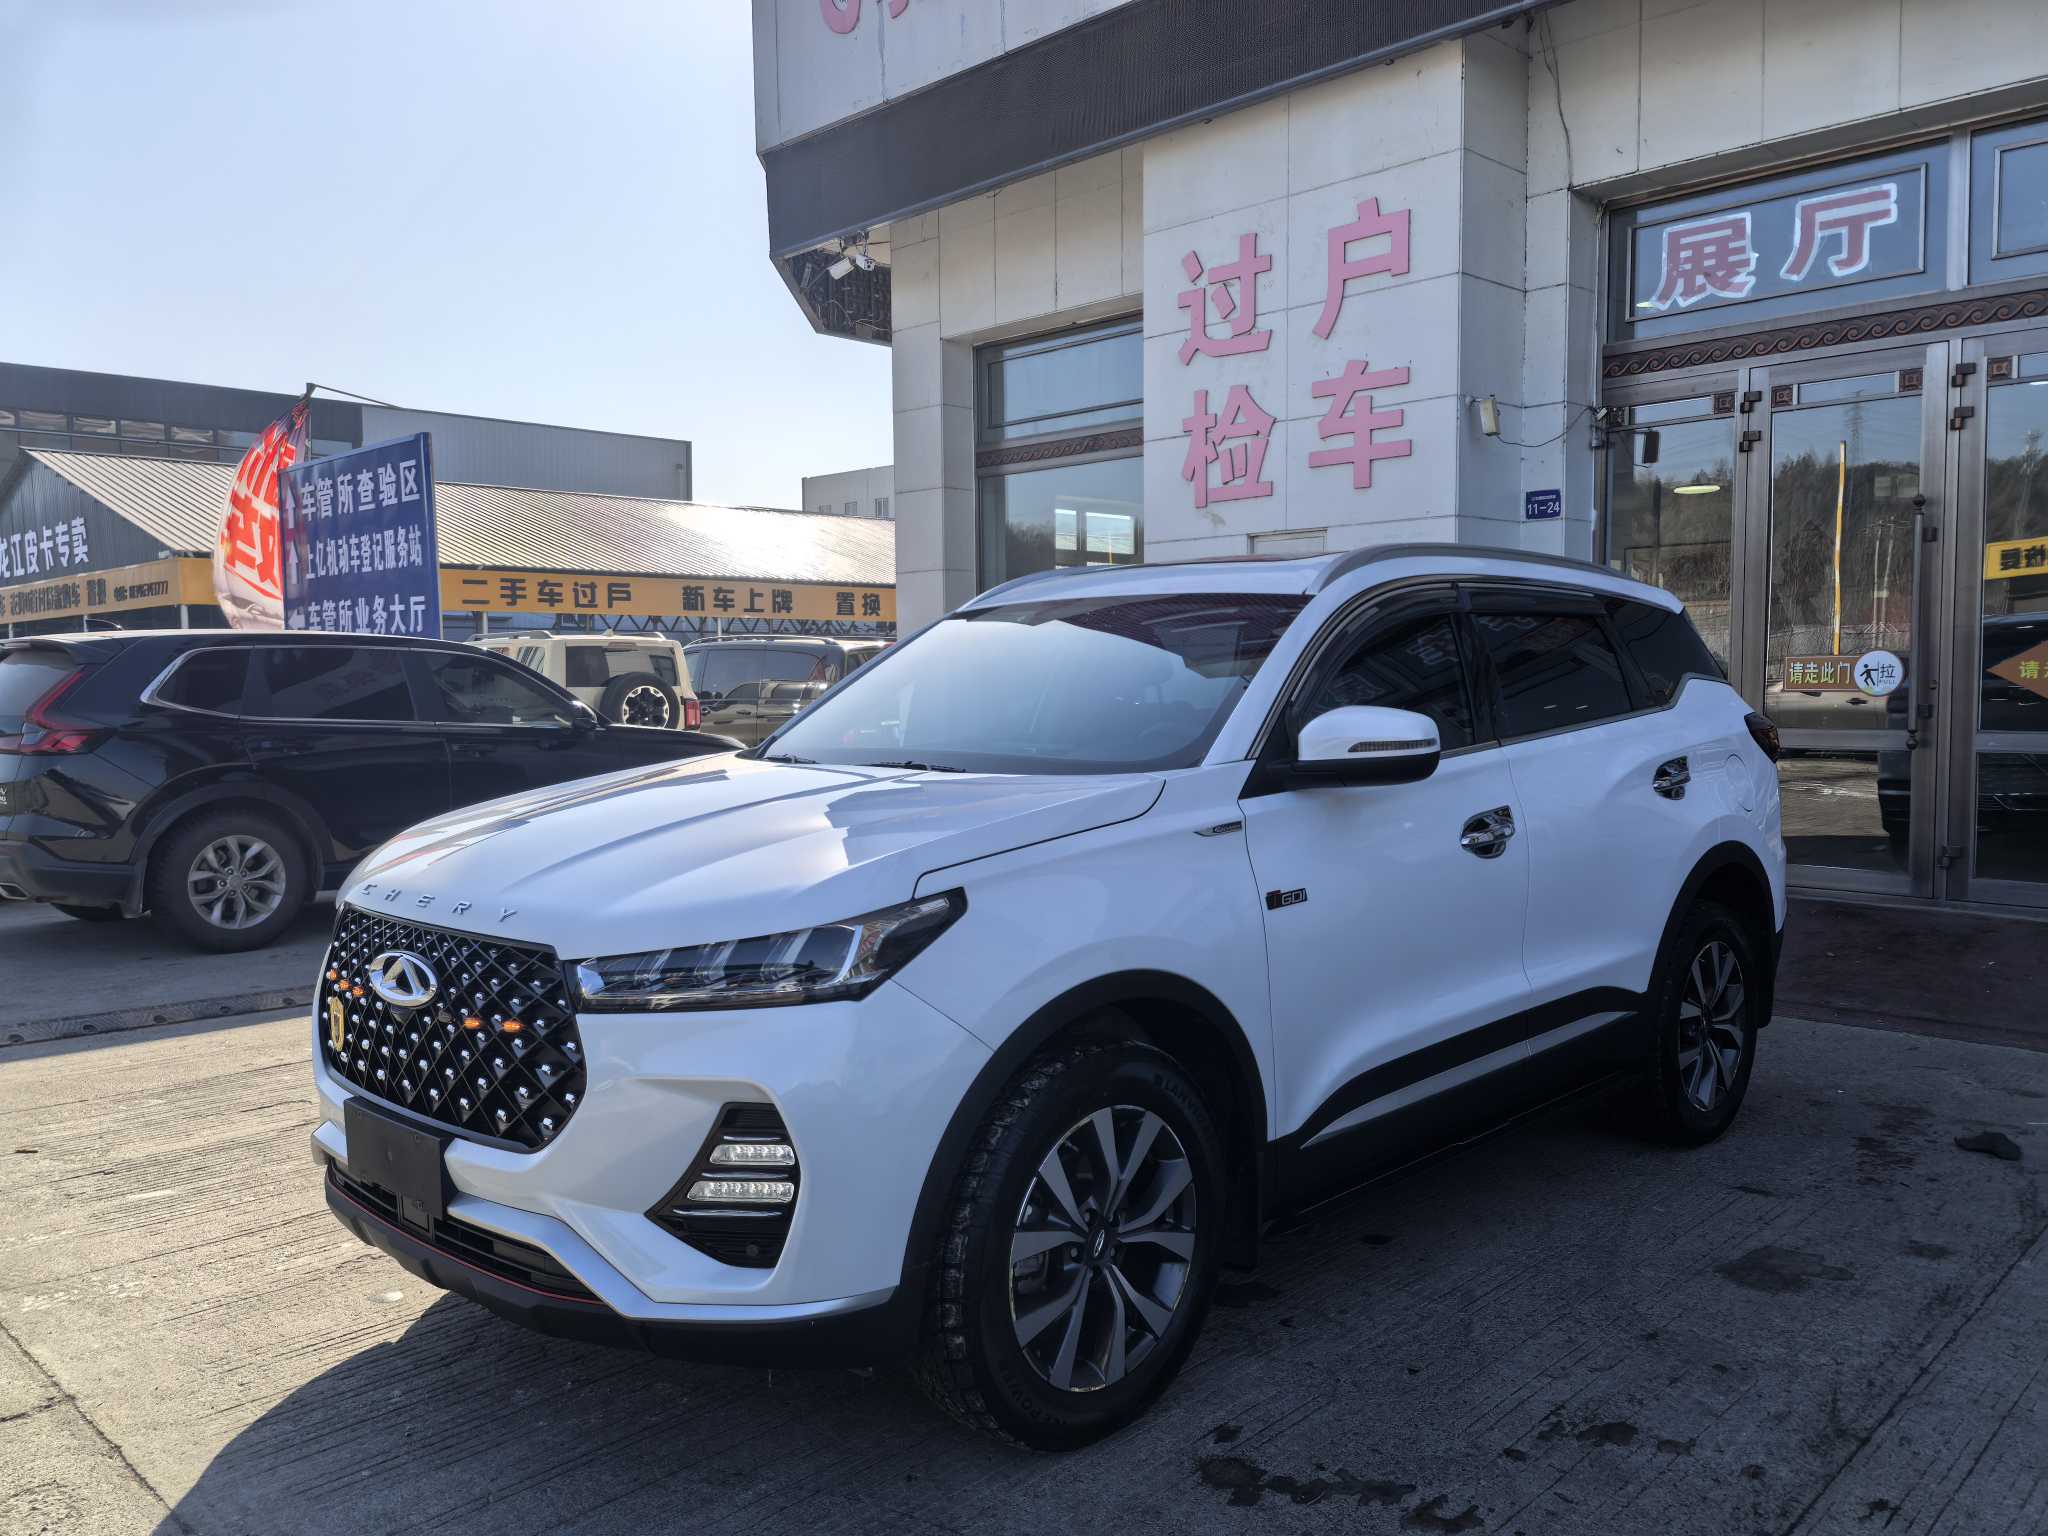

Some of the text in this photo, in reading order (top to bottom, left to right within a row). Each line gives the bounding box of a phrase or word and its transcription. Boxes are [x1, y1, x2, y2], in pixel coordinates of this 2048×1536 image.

[1651, 183, 1898, 311] 展厅
[1177, 197, 1412, 367] 过户
[1181, 359, 1412, 509] 检车
[300, 459, 421, 522] 车管所查验区
[1527, 501, 1561, 515] 11-24
[305, 523, 423, 580] 上亿机动车登记服务站
[307, 592, 426, 635] 车管所业务大厅
[461, 577, 882, 617] 二手车过户 新车上牌 置换
[1789, 661, 1851, 684] 请走此门
[2018, 660, 2048, 680] 请
[360, 882, 518, 923] CHERY
